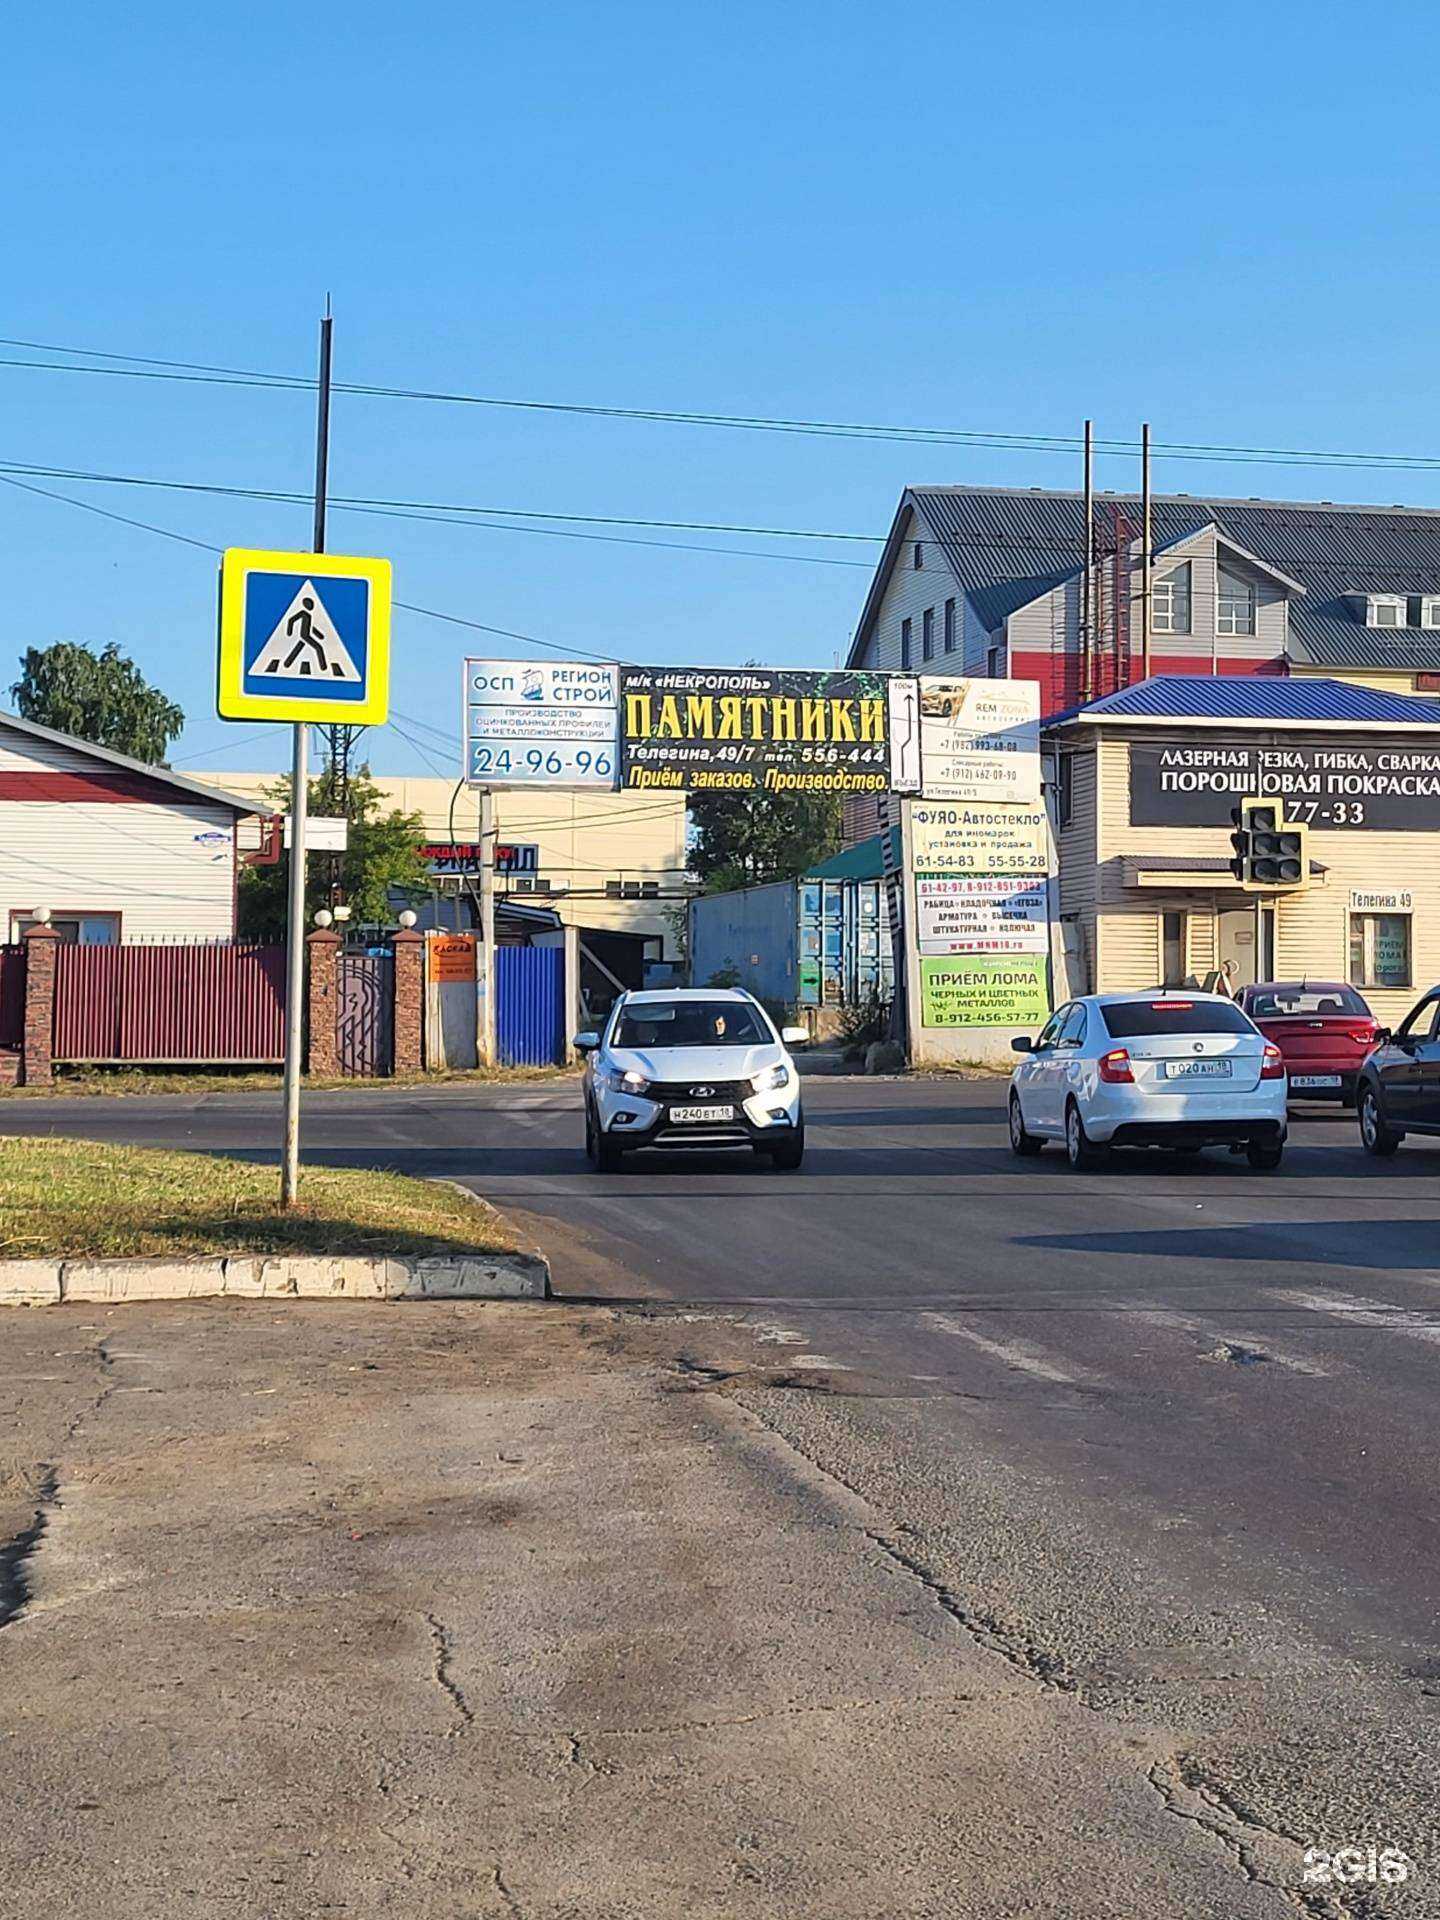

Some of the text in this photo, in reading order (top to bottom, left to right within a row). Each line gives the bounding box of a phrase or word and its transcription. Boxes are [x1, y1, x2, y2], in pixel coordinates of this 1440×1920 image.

[474, 676, 514, 690] ОСП
[552, 670, 611, 684] РЕГИОН
[626, 674, 771, 690] м/к «НЕКРОПОЛЬ»
[553, 686, 611, 701] СТРОЙ
[505, 709, 582, 718] ПРОИЗВОДСТВО
[975, 703, 997, 713] REM
[475, 719, 556, 728] ОЦИНКОВАННЫХ
[625, 694, 885, 742] ПАМЯТНИКИ
[801, 747, 885, 763] 556-444
[1160, 749, 1249, 767] ЛАЗЕРНАЯ
[1314, 753, 1373, 773] ГИБКА,
[477, 748, 611, 776] 24-96-96
[629, 766, 889, 793] Приём заказов. Производство.
[952, 769, 972, 781] (912)
[1327, 774, 1440, 796] ПОКРАСКА
[945, 830, 1015, 838] для иномарок
[929, 841, 978, 849] установка
[991, 841, 1032, 849] продажа
[916, 855, 1046, 867] 61-54-83 55-55-28
[924, 900, 954, 908] РАБИЦА
[960, 899, 1006, 908] КЛАДОЧНАЯ
[1352, 892, 1412, 908] Телегина 49
[938, 911, 977, 921] АРМАТУРА
[932, 924, 987, 934] ШТУКАТУРНАЯ
[929, 970, 1038, 986] ПРИЁМ ЛОМА
[931, 989, 1039, 999] ЧЕРНЫХ И ЦВЕТНЫХ
[957, 999, 1015, 1008] МЕТАЛЛОВ
[935, 1012, 1039, 1024] 8-912-456-57-77
